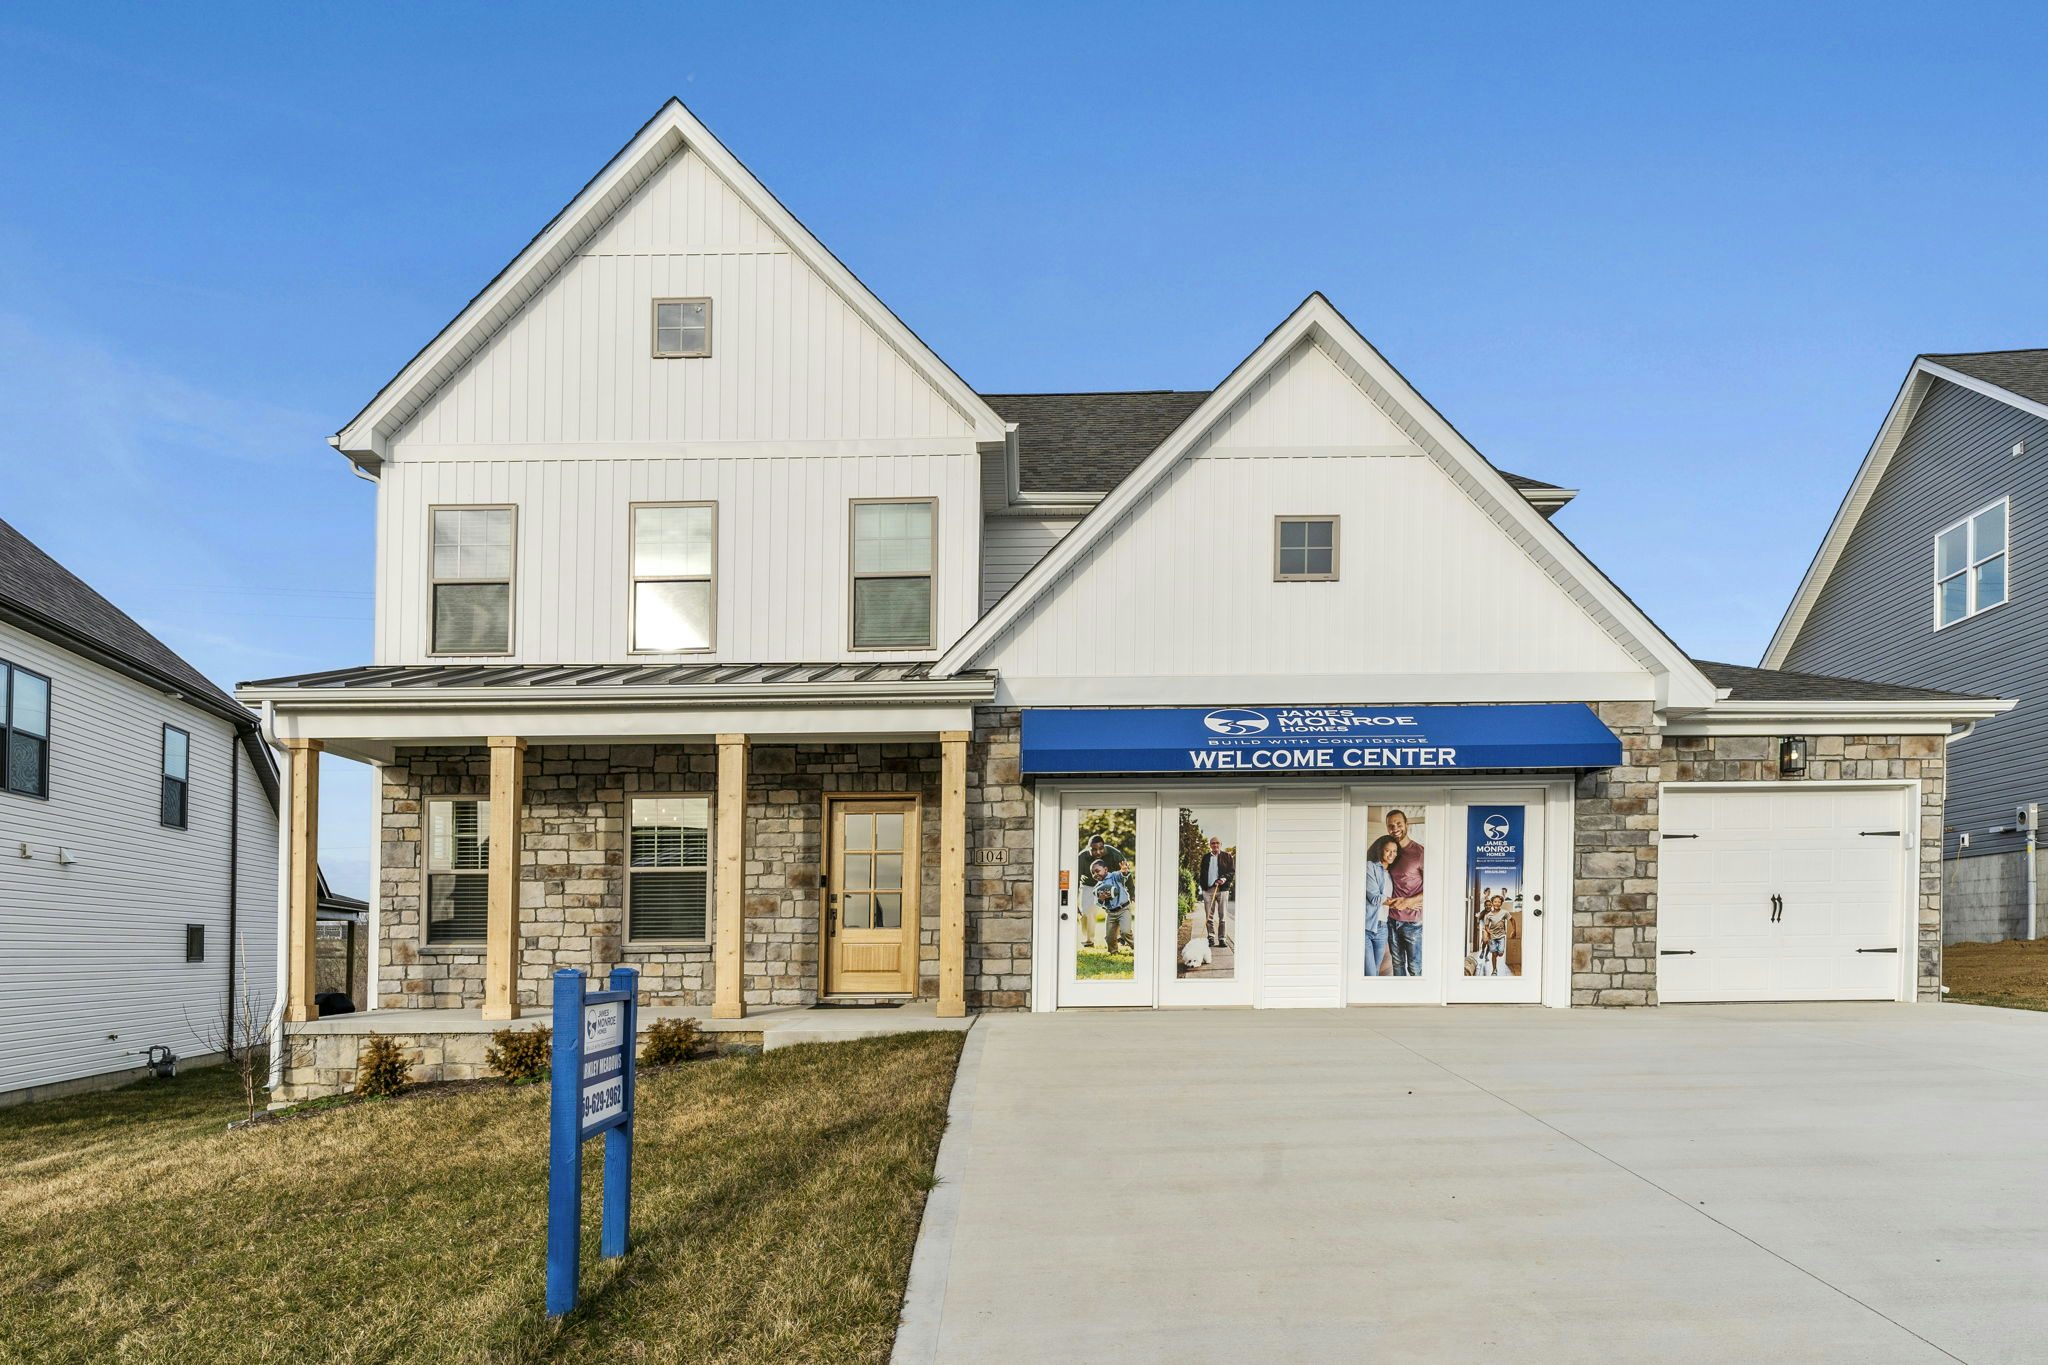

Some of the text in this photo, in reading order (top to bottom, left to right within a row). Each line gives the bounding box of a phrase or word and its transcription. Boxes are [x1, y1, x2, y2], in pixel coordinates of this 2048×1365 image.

[1278, 717, 1418, 726] MONROE
[1189, 747, 1457, 768] WELCOME CENTER
[980, 850, 1003, 862] 104
[598, 1009, 609, 1017] JAMES
[597, 1016, 616, 1027] MONROE
[599, 1053, 622, 1074] MEADOWS
